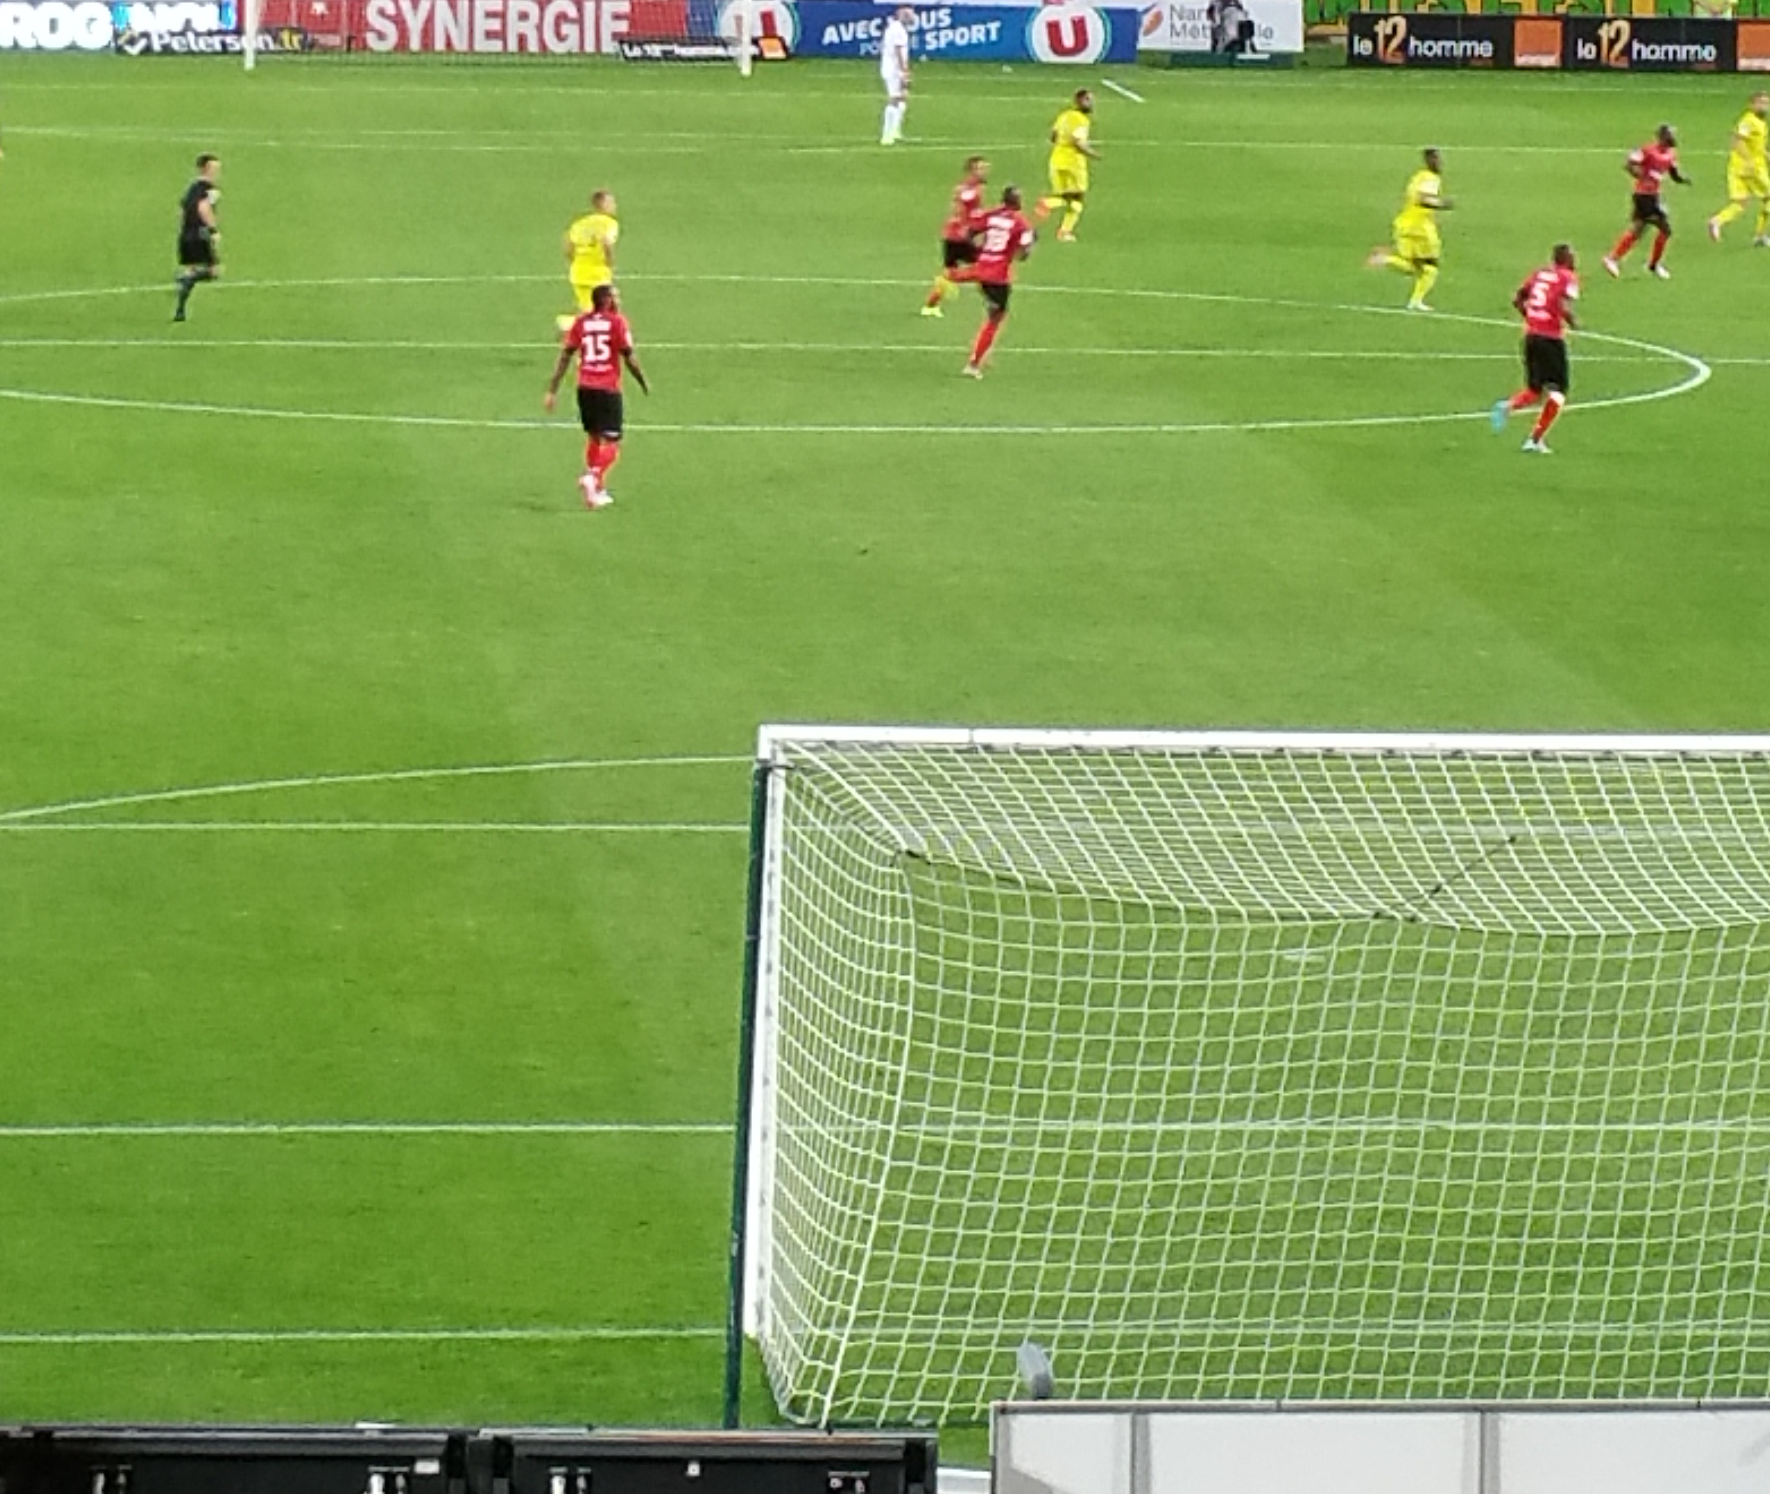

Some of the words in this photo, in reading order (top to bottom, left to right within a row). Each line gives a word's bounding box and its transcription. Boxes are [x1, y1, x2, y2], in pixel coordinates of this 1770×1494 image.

[821, 17, 882, 46] AVEC
[925, 20, 1001, 51] SPORT
[1409, 35, 1494, 58] homme
[1631, 38, 1717, 62] homme
[581, 333, 611, 363] 15
